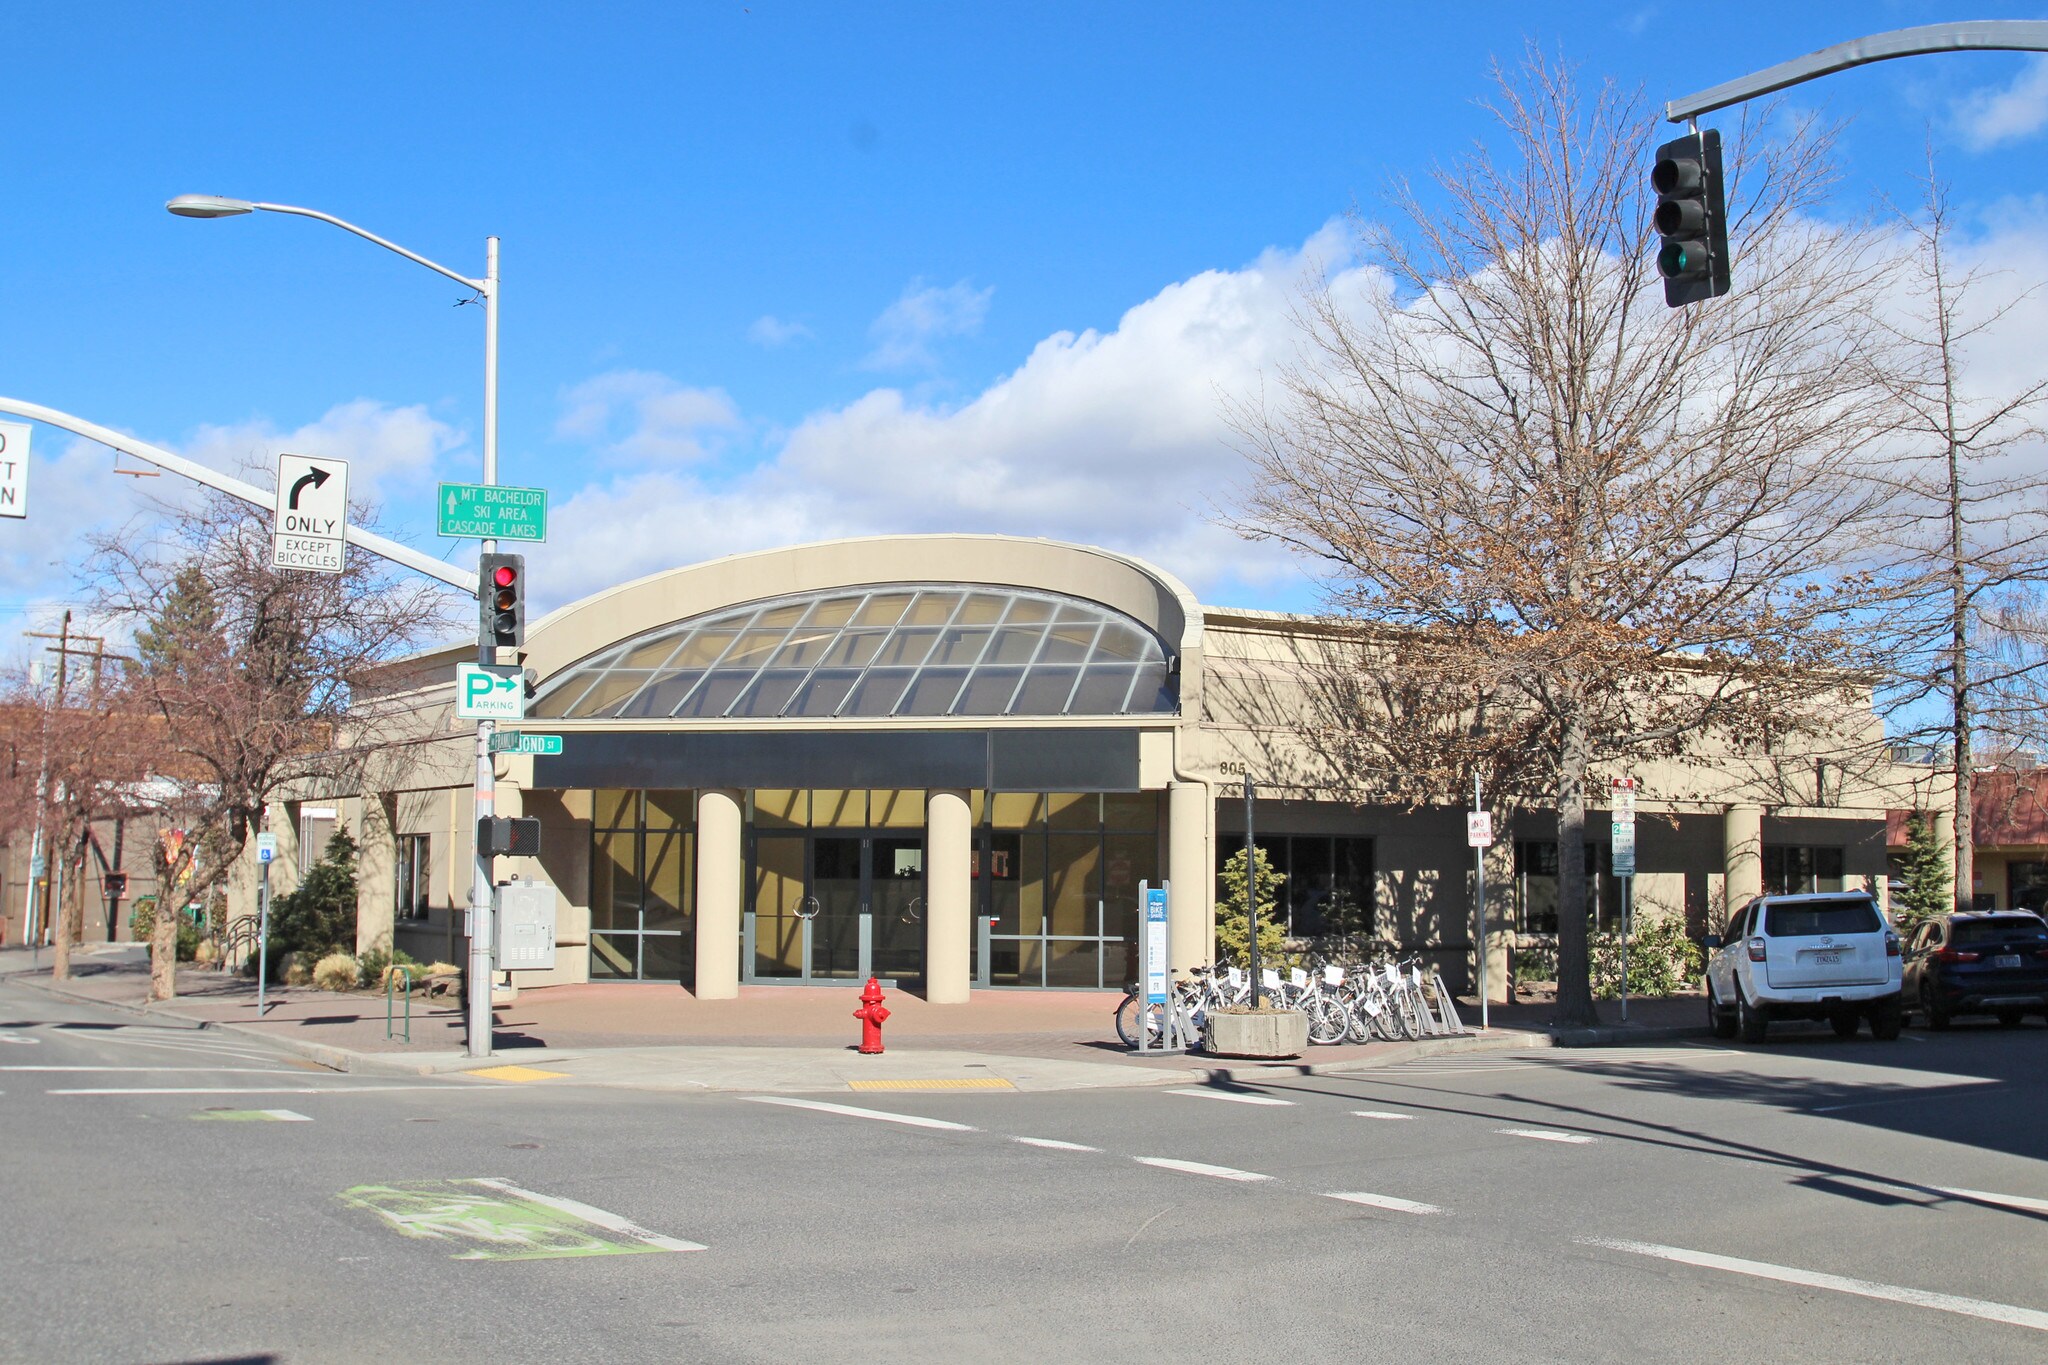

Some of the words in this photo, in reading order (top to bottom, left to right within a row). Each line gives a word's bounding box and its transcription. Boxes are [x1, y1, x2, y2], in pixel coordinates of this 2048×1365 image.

[461, 488, 478, 501] MT
[484, 490, 541, 506] BACHELOR
[473, 505, 490, 519] SKI
[498, 507, 527, 521] AREA
[286, 515, 336, 535] ONLY
[447, 519, 496, 535] CASCADE
[503, 523, 537, 537] LAKES
[286, 539, 332, 554] EXCEPT
[277, 551, 338, 567] BICYCLES
[547, 741, 555, 749] ST
[1219, 761, 1246, 776] 805
[1473, 819, 1485, 828] NO
[1150, 906, 1163, 914] BIKE
